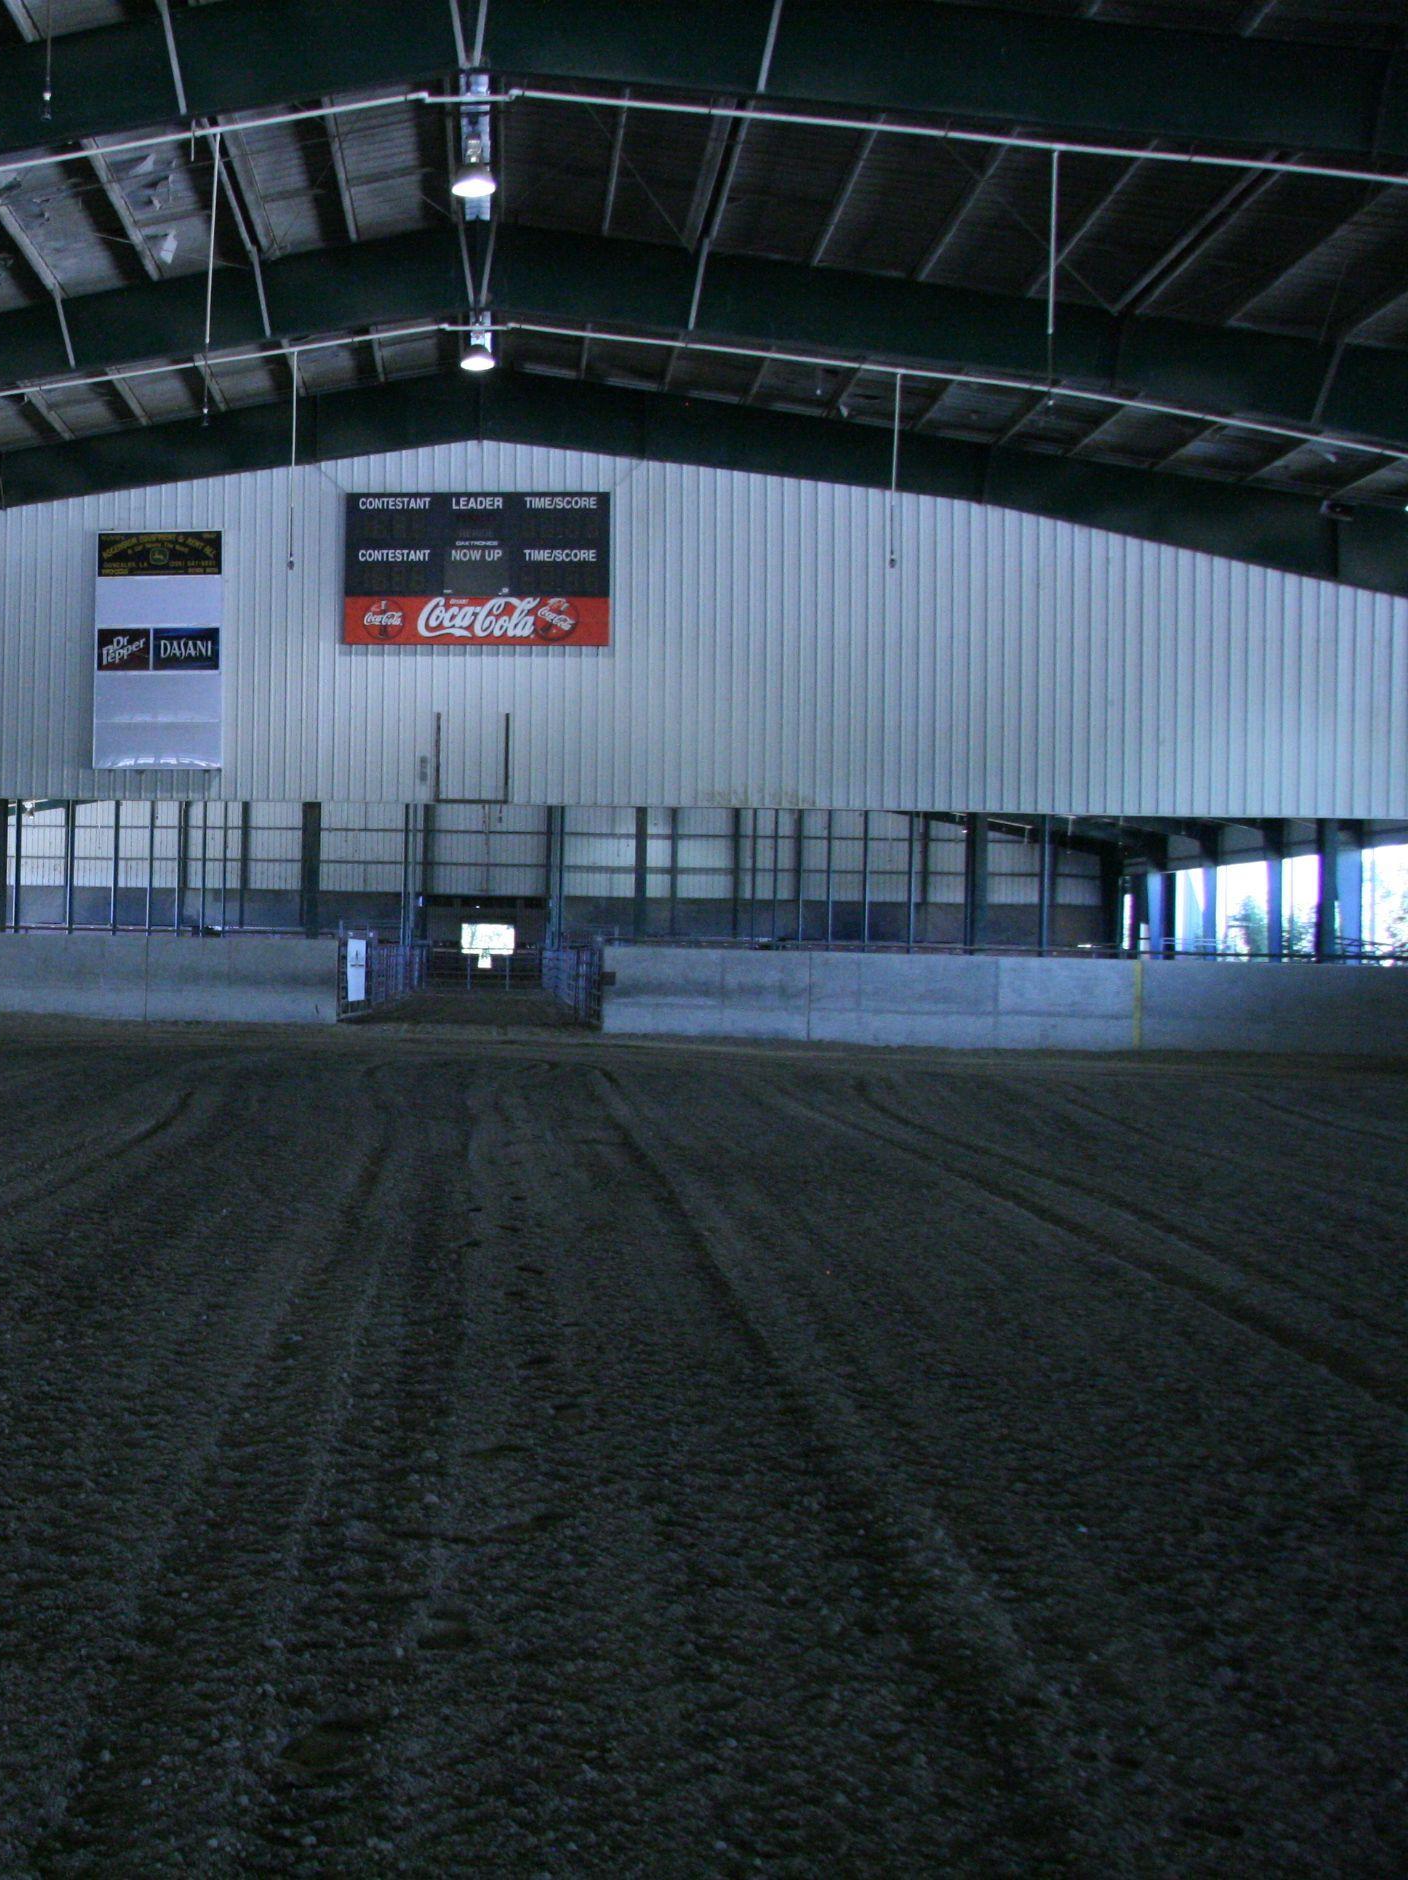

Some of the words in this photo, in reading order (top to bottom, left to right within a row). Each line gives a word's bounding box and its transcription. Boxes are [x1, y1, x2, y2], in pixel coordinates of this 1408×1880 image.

[359, 497, 431, 510] CONTESTANT
[452, 497, 503, 510] LEADER
[525, 497, 598, 509] TIME/SCORE
[358, 549, 431, 562] CONTESTANT
[451, 549, 483, 562] NOW
[485, 549, 503, 562] UP
[524, 549, 598, 562] TIME/SCORE
[417, 596, 542, 638] Coca-Cola
[113, 635, 130, 650] Dr
[161, 637, 212, 659] DASANI
[102, 638, 146, 666] Pepper
